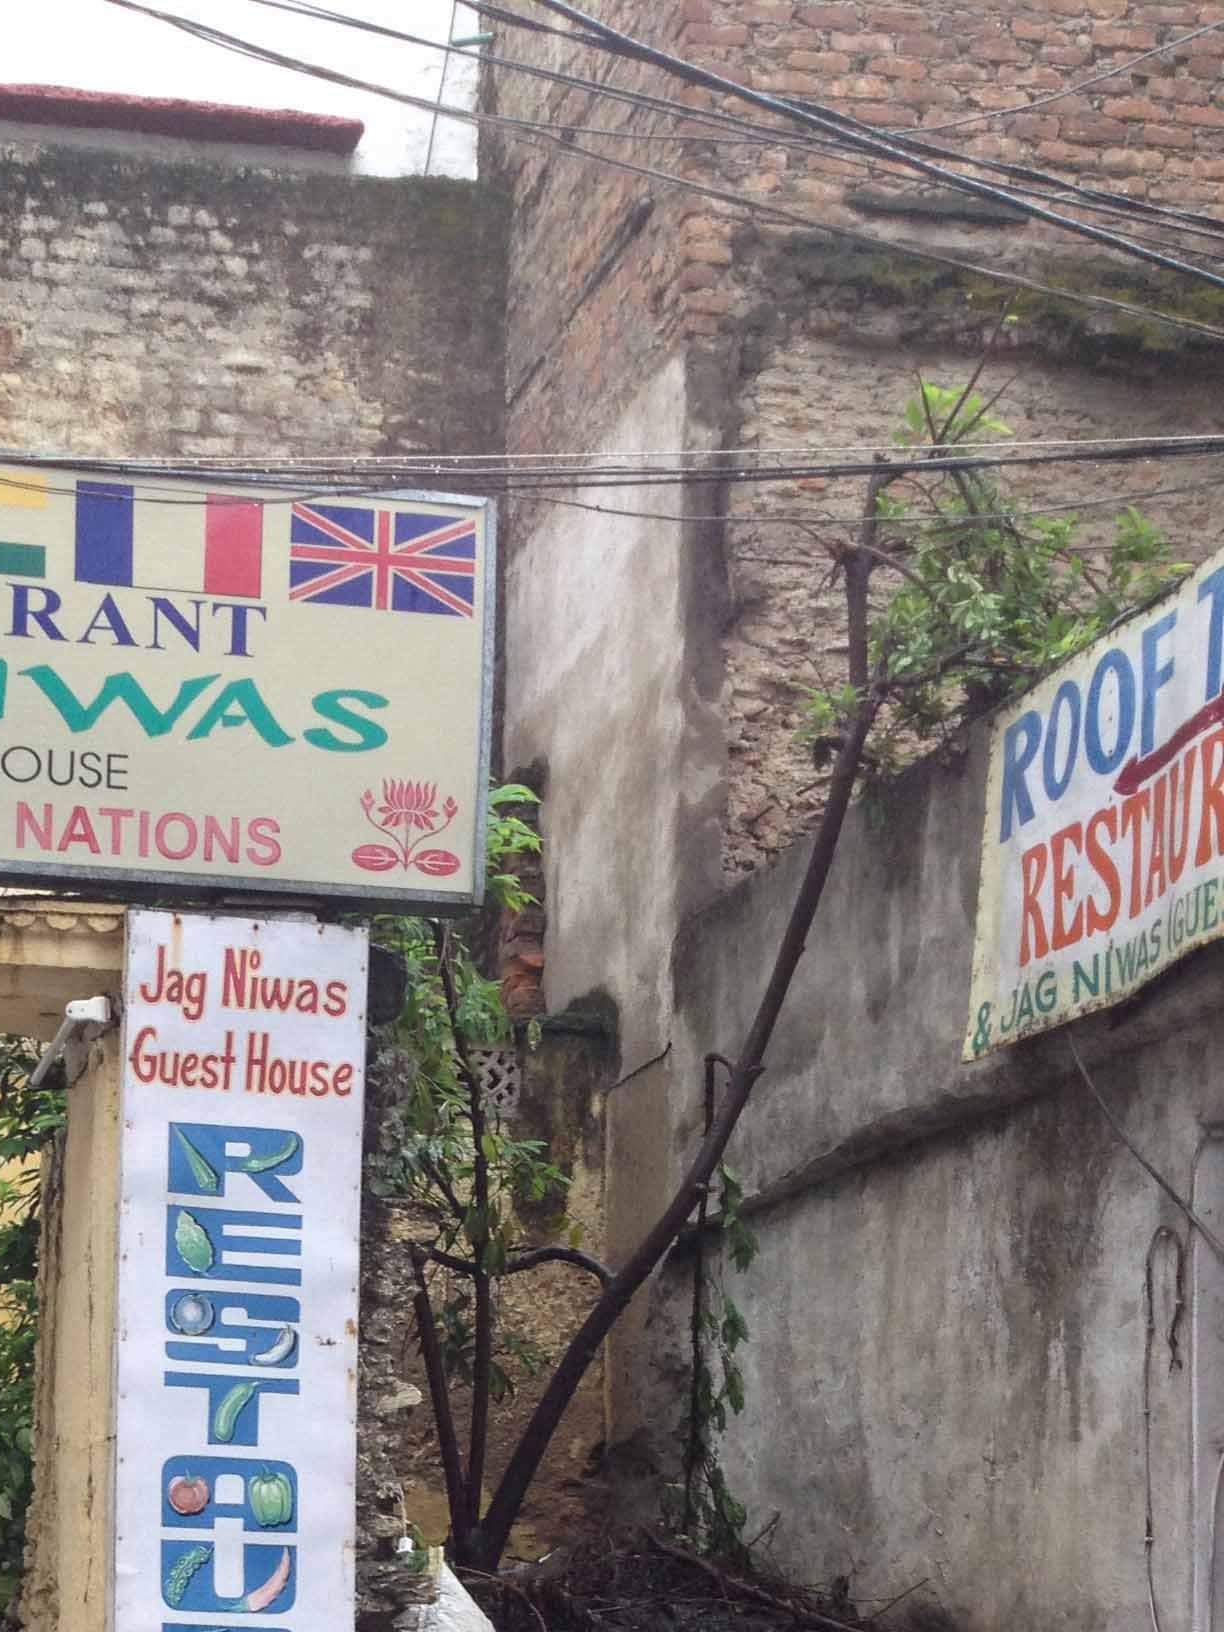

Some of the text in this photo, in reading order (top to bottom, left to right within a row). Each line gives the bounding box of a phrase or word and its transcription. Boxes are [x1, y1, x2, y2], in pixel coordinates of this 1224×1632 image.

[1000, 609, 1178, 843] ROOF
[16, 801, 282, 866] NATIONS
[140, 945, 348, 1020] Jag Niwas
[972, 1001, 992, 1053] &
[1000, 970, 1057, 1036] JAG
[1073, 918, 1162, 1004] NIWAS
[129, 1026, 355, 1097] Guest House
